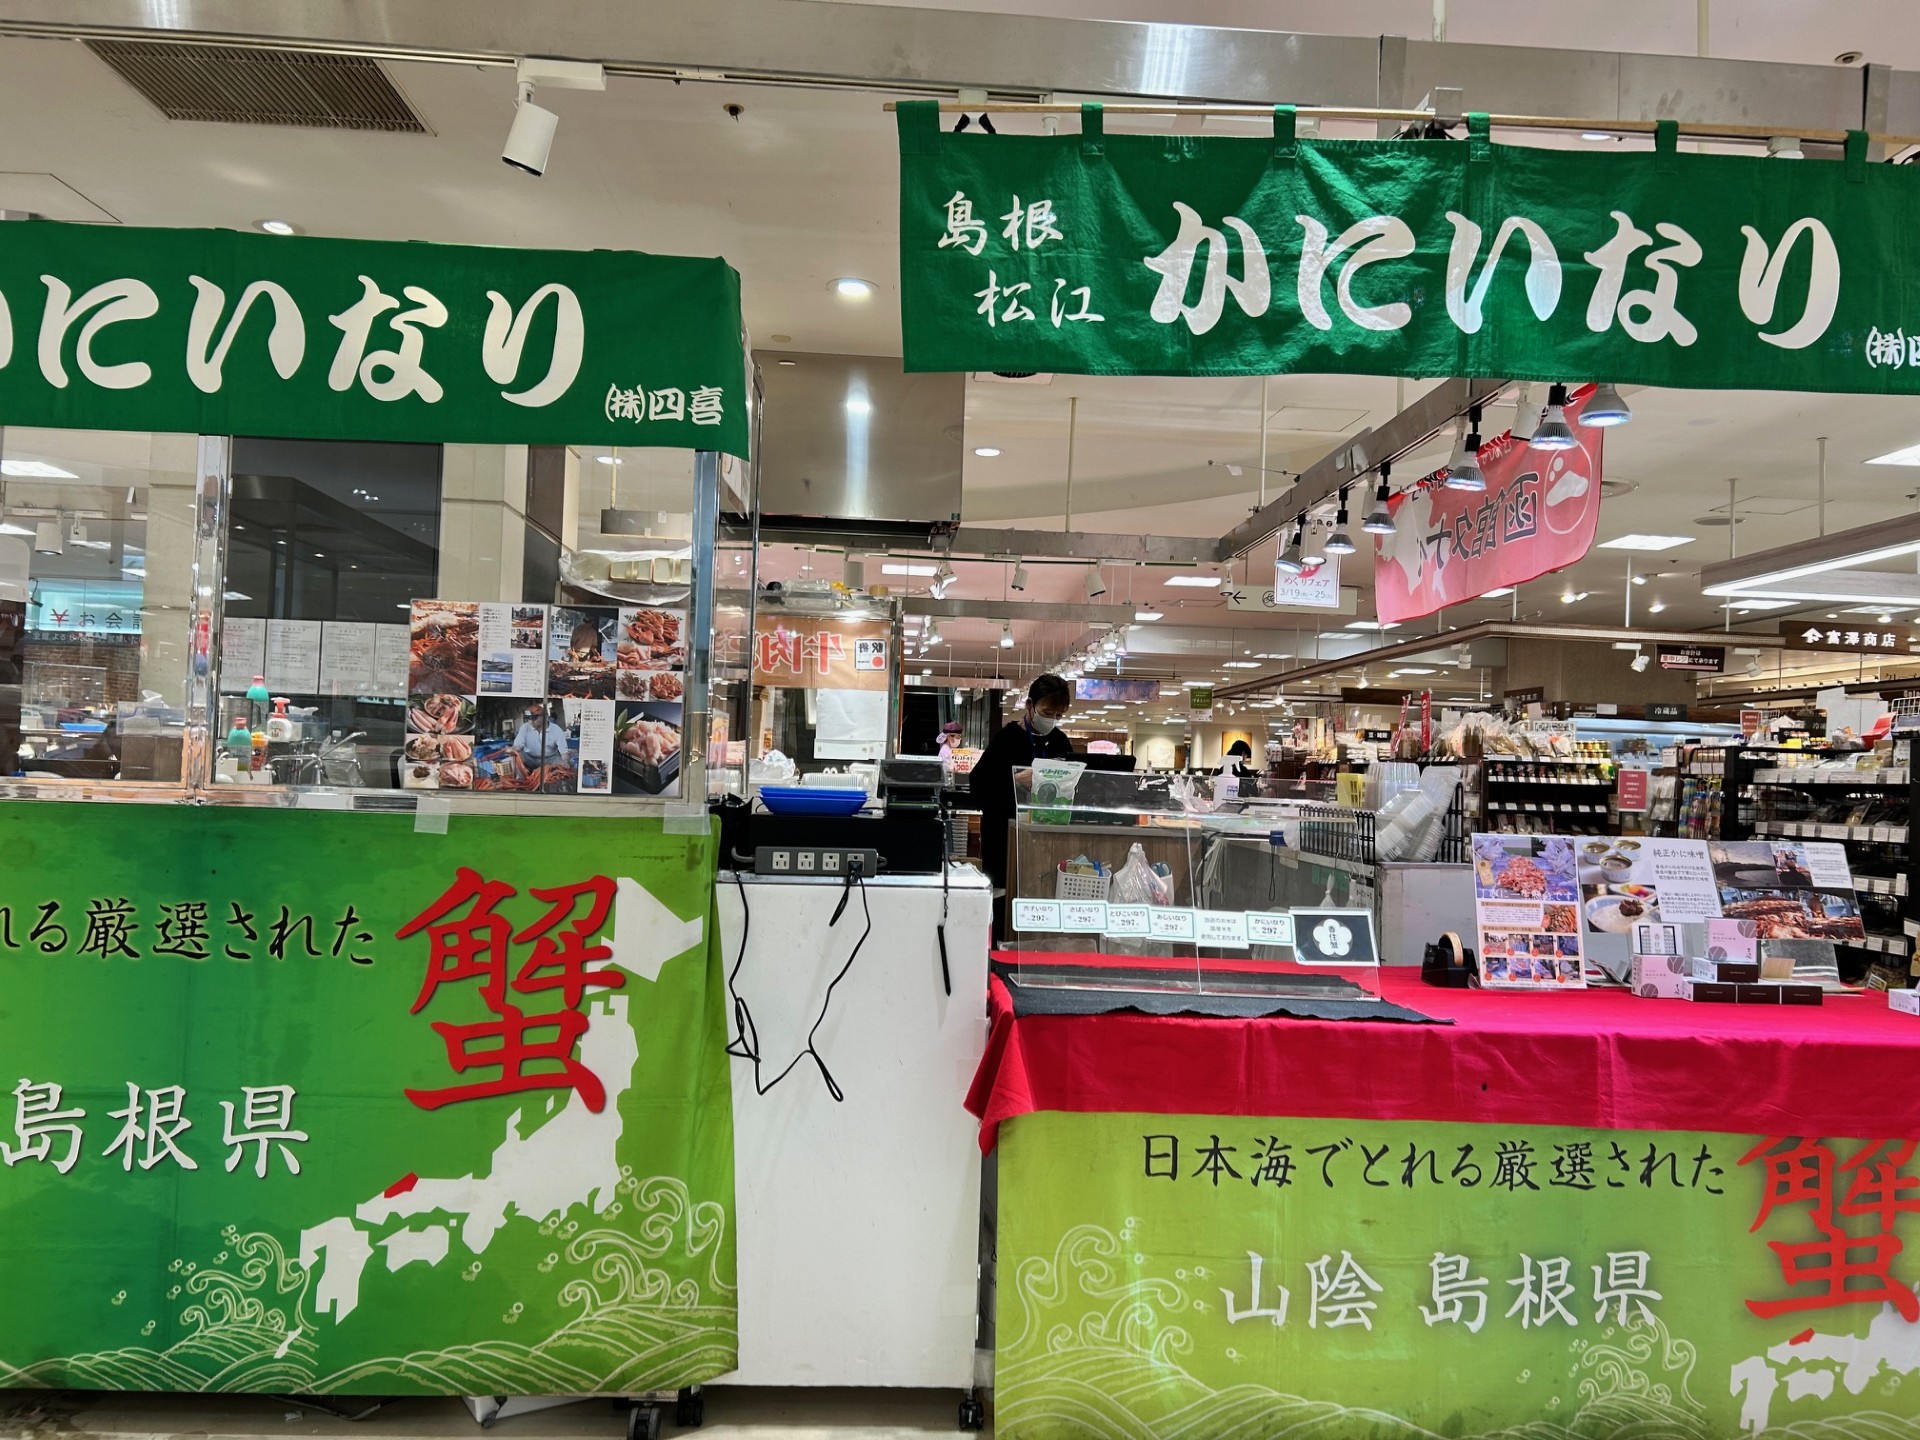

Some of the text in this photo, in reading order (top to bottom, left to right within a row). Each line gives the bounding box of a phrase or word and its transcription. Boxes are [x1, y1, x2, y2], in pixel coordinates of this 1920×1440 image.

[938, 191, 1063, 256] 島根
[973, 269, 1105, 328] 松江
[1145, 202, 1841, 349] かにいなり
[0, 273, 585, 408] にいなり
[1826, 630, 1896, 648] 富澤商店
[1654, 706, 1678, 715] 冷蔵品
[1156, 914, 1187, 922] あじいなり
[1254, 918, 1285, 926] かにいなり
[396, 866, 626, 1114] 蟹
[0, 1078, 309, 1179] 島根県
[1142, 1134, 1725, 1196] 日本海でとれる厳選された
[1220, 1249, 1664, 1333] 山陰 島根県
